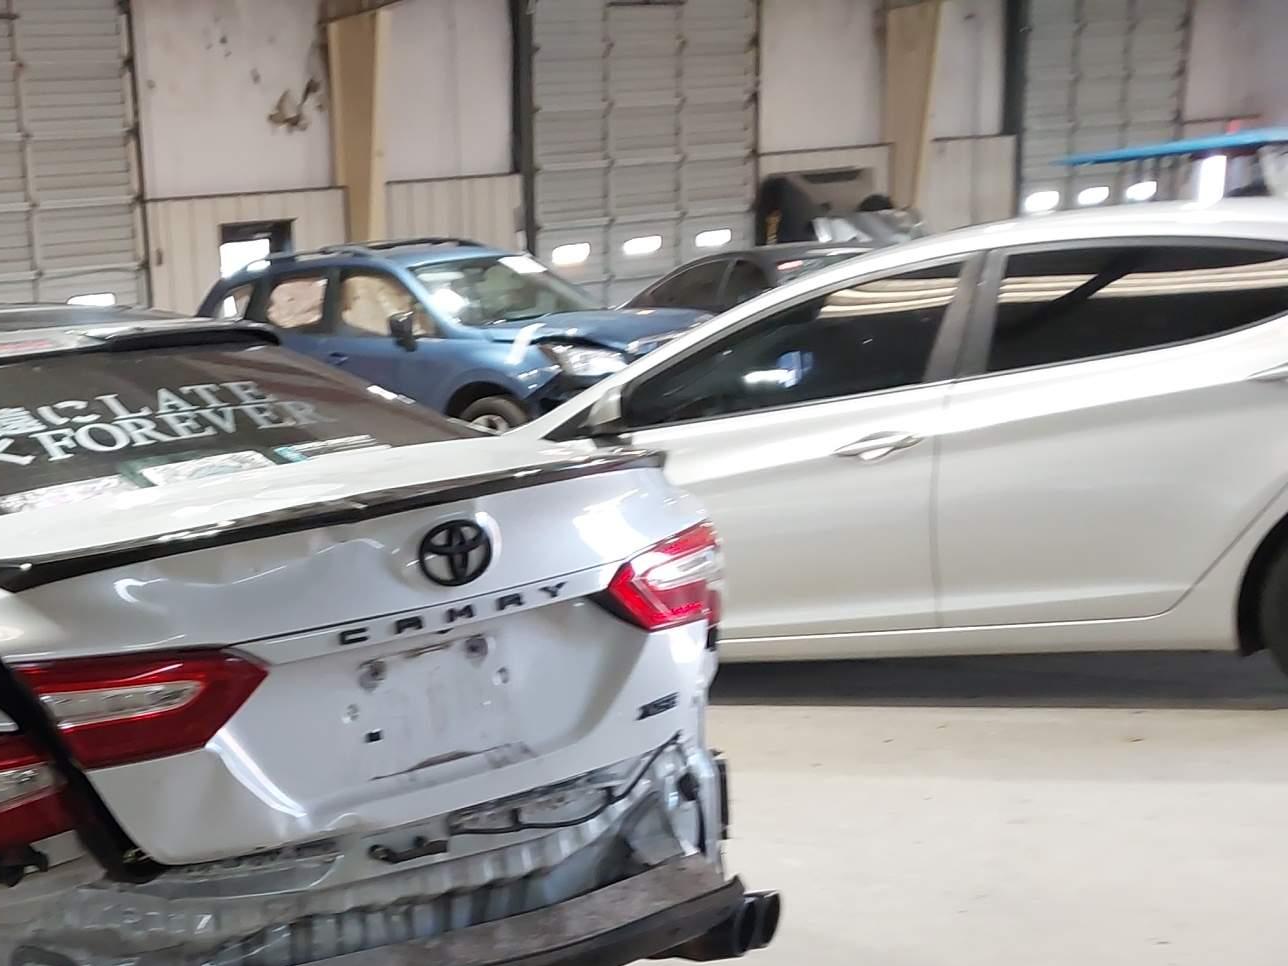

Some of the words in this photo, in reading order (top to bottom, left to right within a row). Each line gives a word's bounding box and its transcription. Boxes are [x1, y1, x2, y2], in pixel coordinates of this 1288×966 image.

[28, 400, 336, 461] FOREVER
[95, 380, 279, 421] LATE
[338, 581, 567, 646] CAMRY
